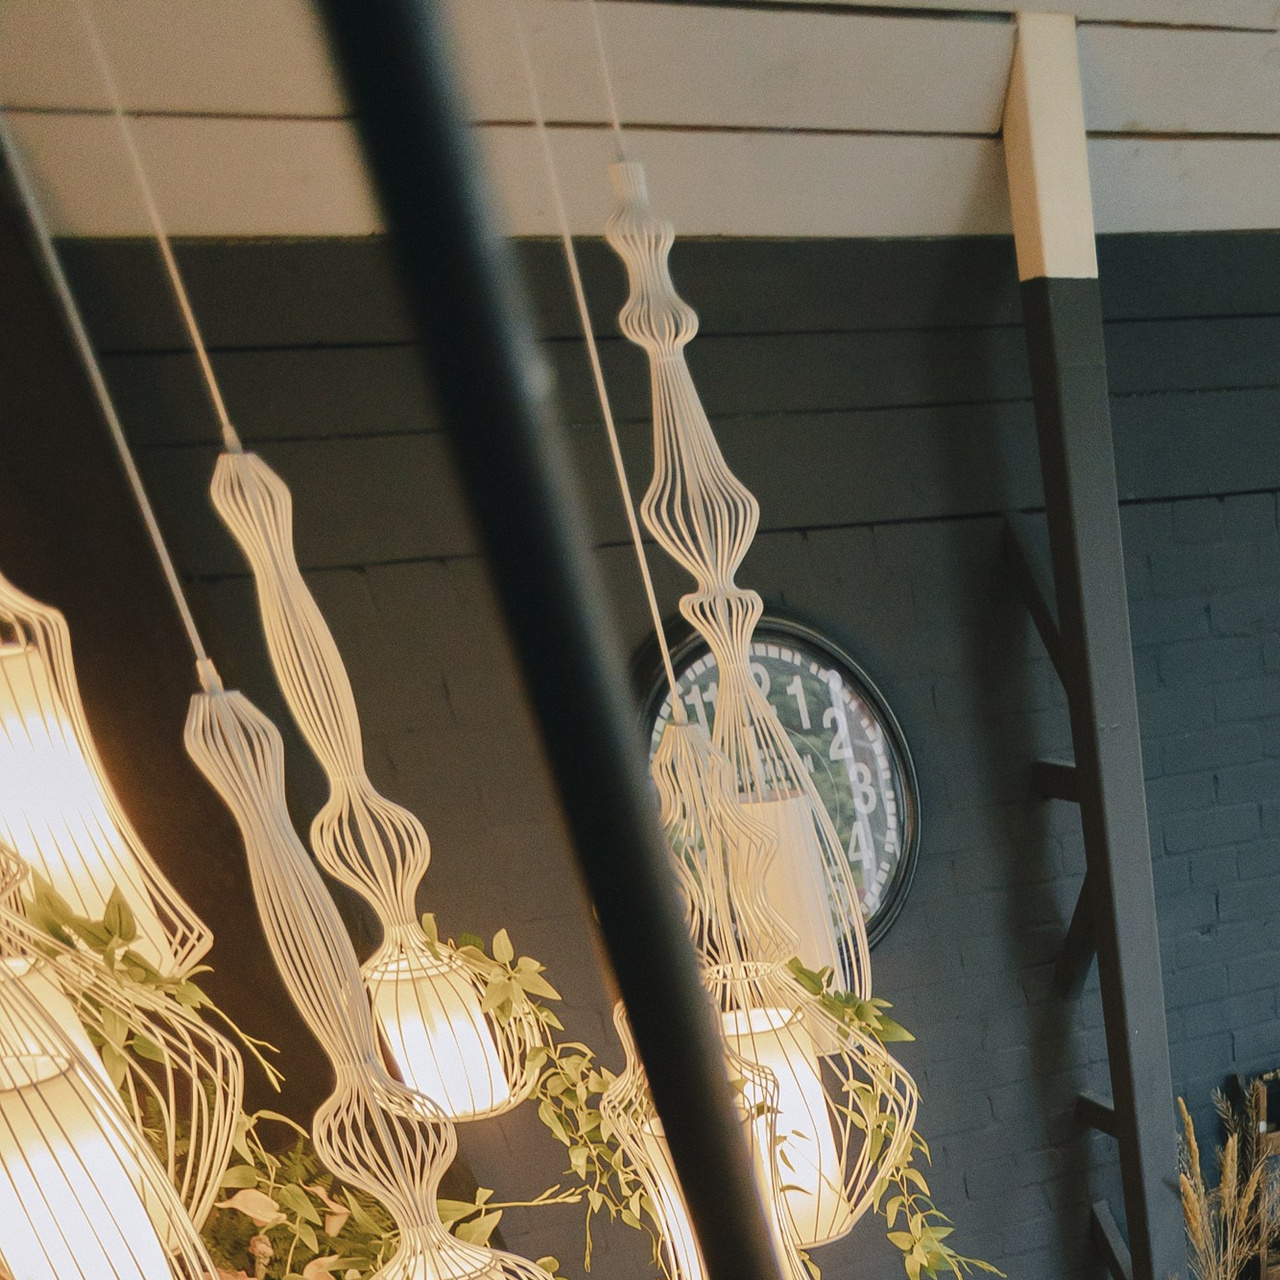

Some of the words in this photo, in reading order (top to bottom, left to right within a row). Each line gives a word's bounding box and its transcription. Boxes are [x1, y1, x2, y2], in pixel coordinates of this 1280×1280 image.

[786, 674, 811, 730] 1
[822, 706, 853, 761] 2
[855, 761, 877, 814] 3
[848, 820, 873, 870] 4
